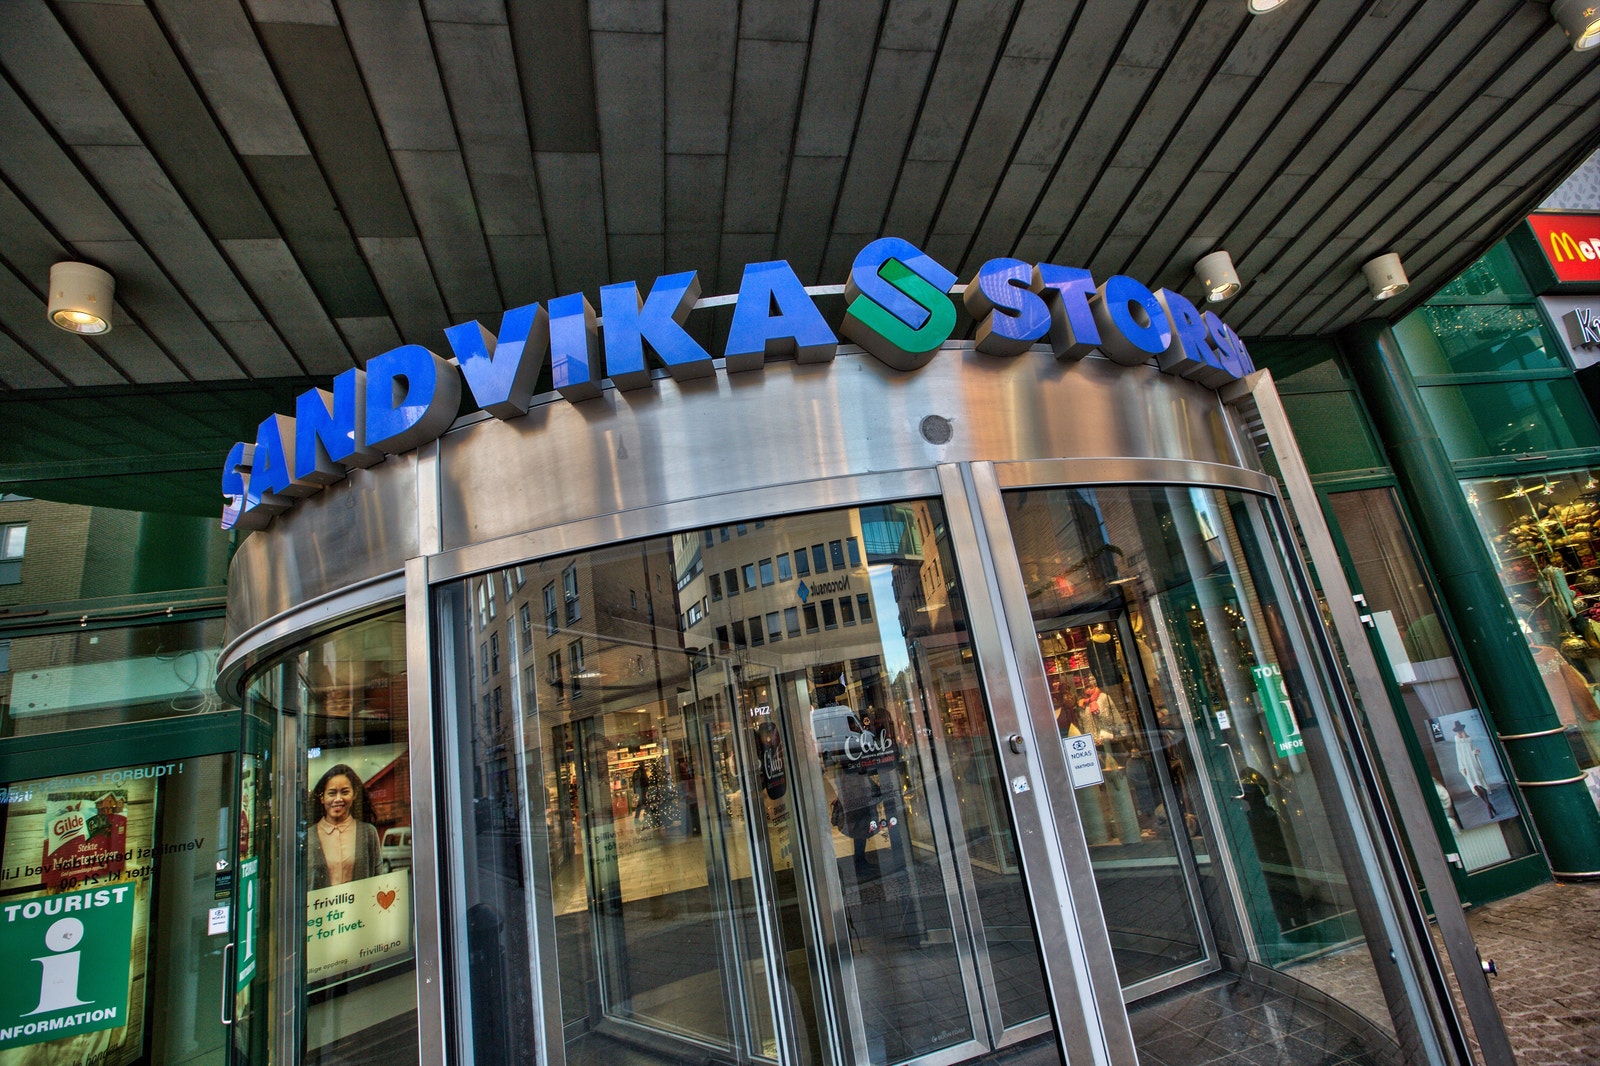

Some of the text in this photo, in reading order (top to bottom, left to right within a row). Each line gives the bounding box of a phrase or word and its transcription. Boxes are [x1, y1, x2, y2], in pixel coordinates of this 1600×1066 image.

[221, 260, 839, 530] SANDVIKA
[1071, 750, 1092, 760] NOKAS
[102, 764, 175, 784] FORBUDT
[54, 815, 84, 836] Gilde
[78, 842, 98, 852] Stekte
[5, 887, 128, 922] TOURIST
[313, 893, 355, 911] frivillig
[326, 909, 345, 922] får
[316, 929, 335, 940] for
[338, 920, 366, 934] livet.
[359, 940, 401, 958] frivillig.no
